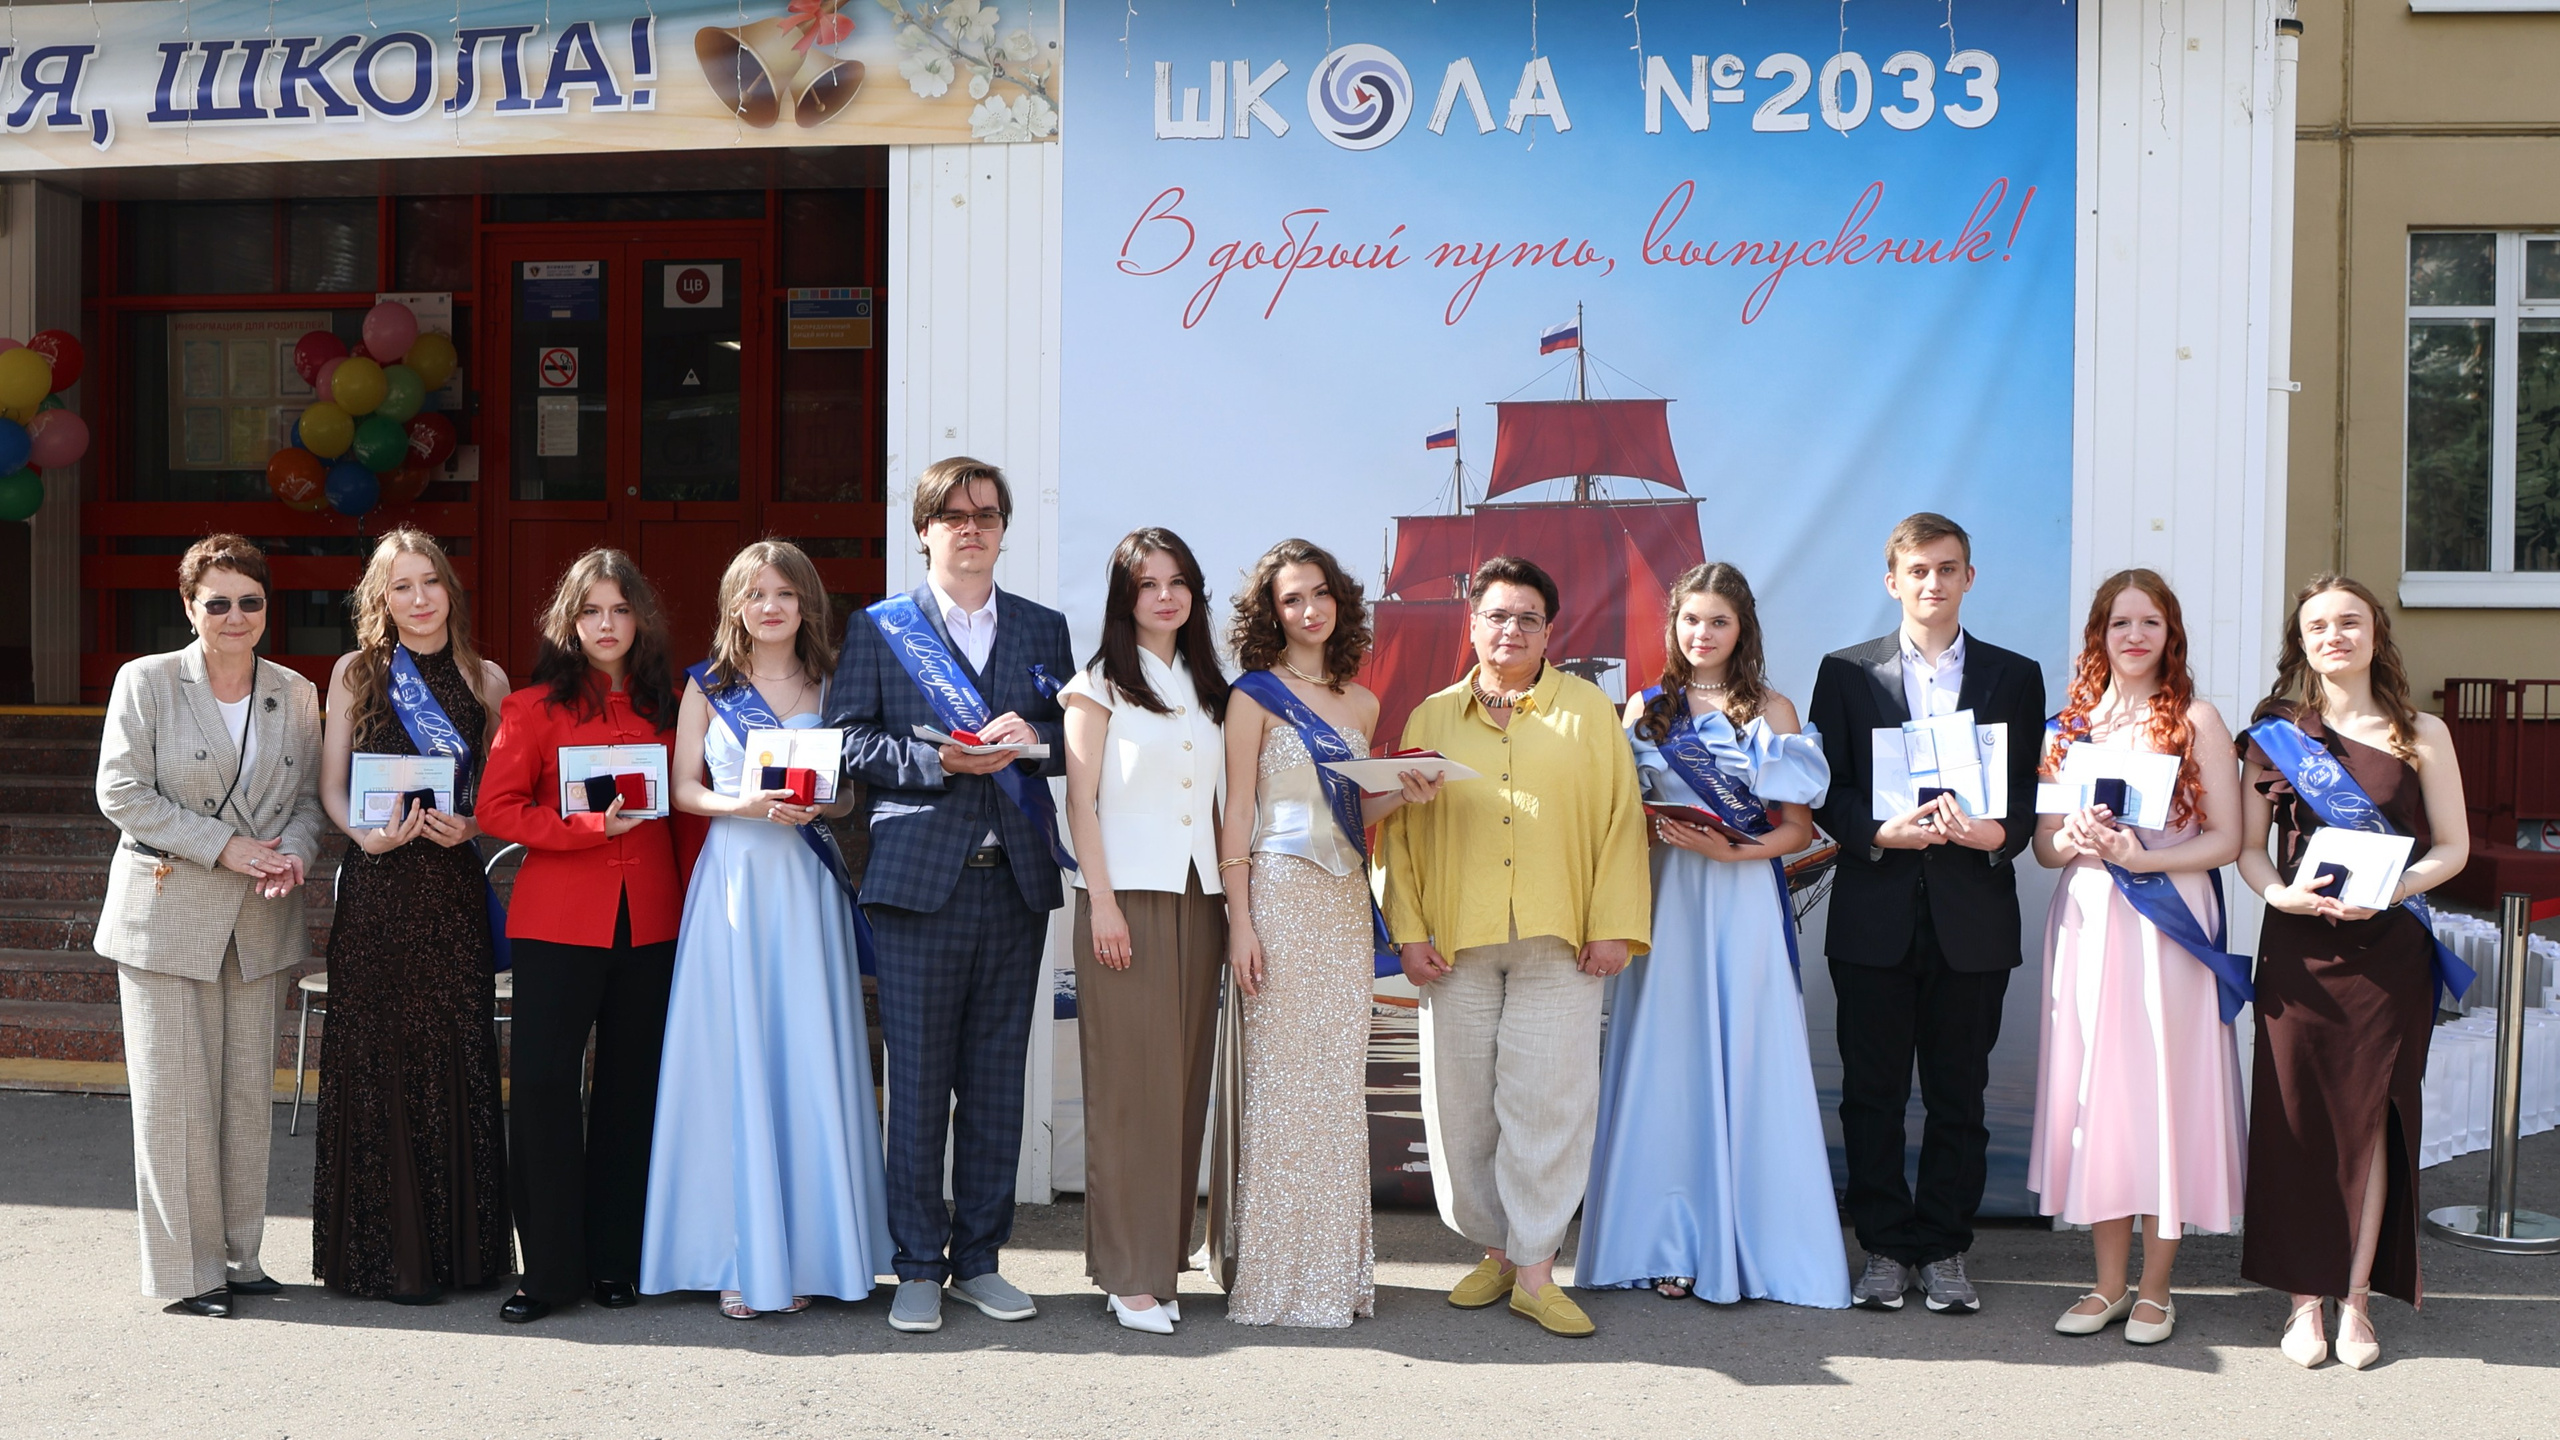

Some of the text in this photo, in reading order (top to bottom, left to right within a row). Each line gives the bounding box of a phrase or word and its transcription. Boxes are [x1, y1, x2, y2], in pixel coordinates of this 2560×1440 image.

[146, 15, 657, 125] ШКОЛА!
[1116, 177, 2038, 330] В добрый путь, выпускник!
[683, 278, 703, 294] ЦВ
[174, 320, 324, 332] ИНФОРМАЦИЯ ДЛЯ РОДИТЕЛЕЙ
